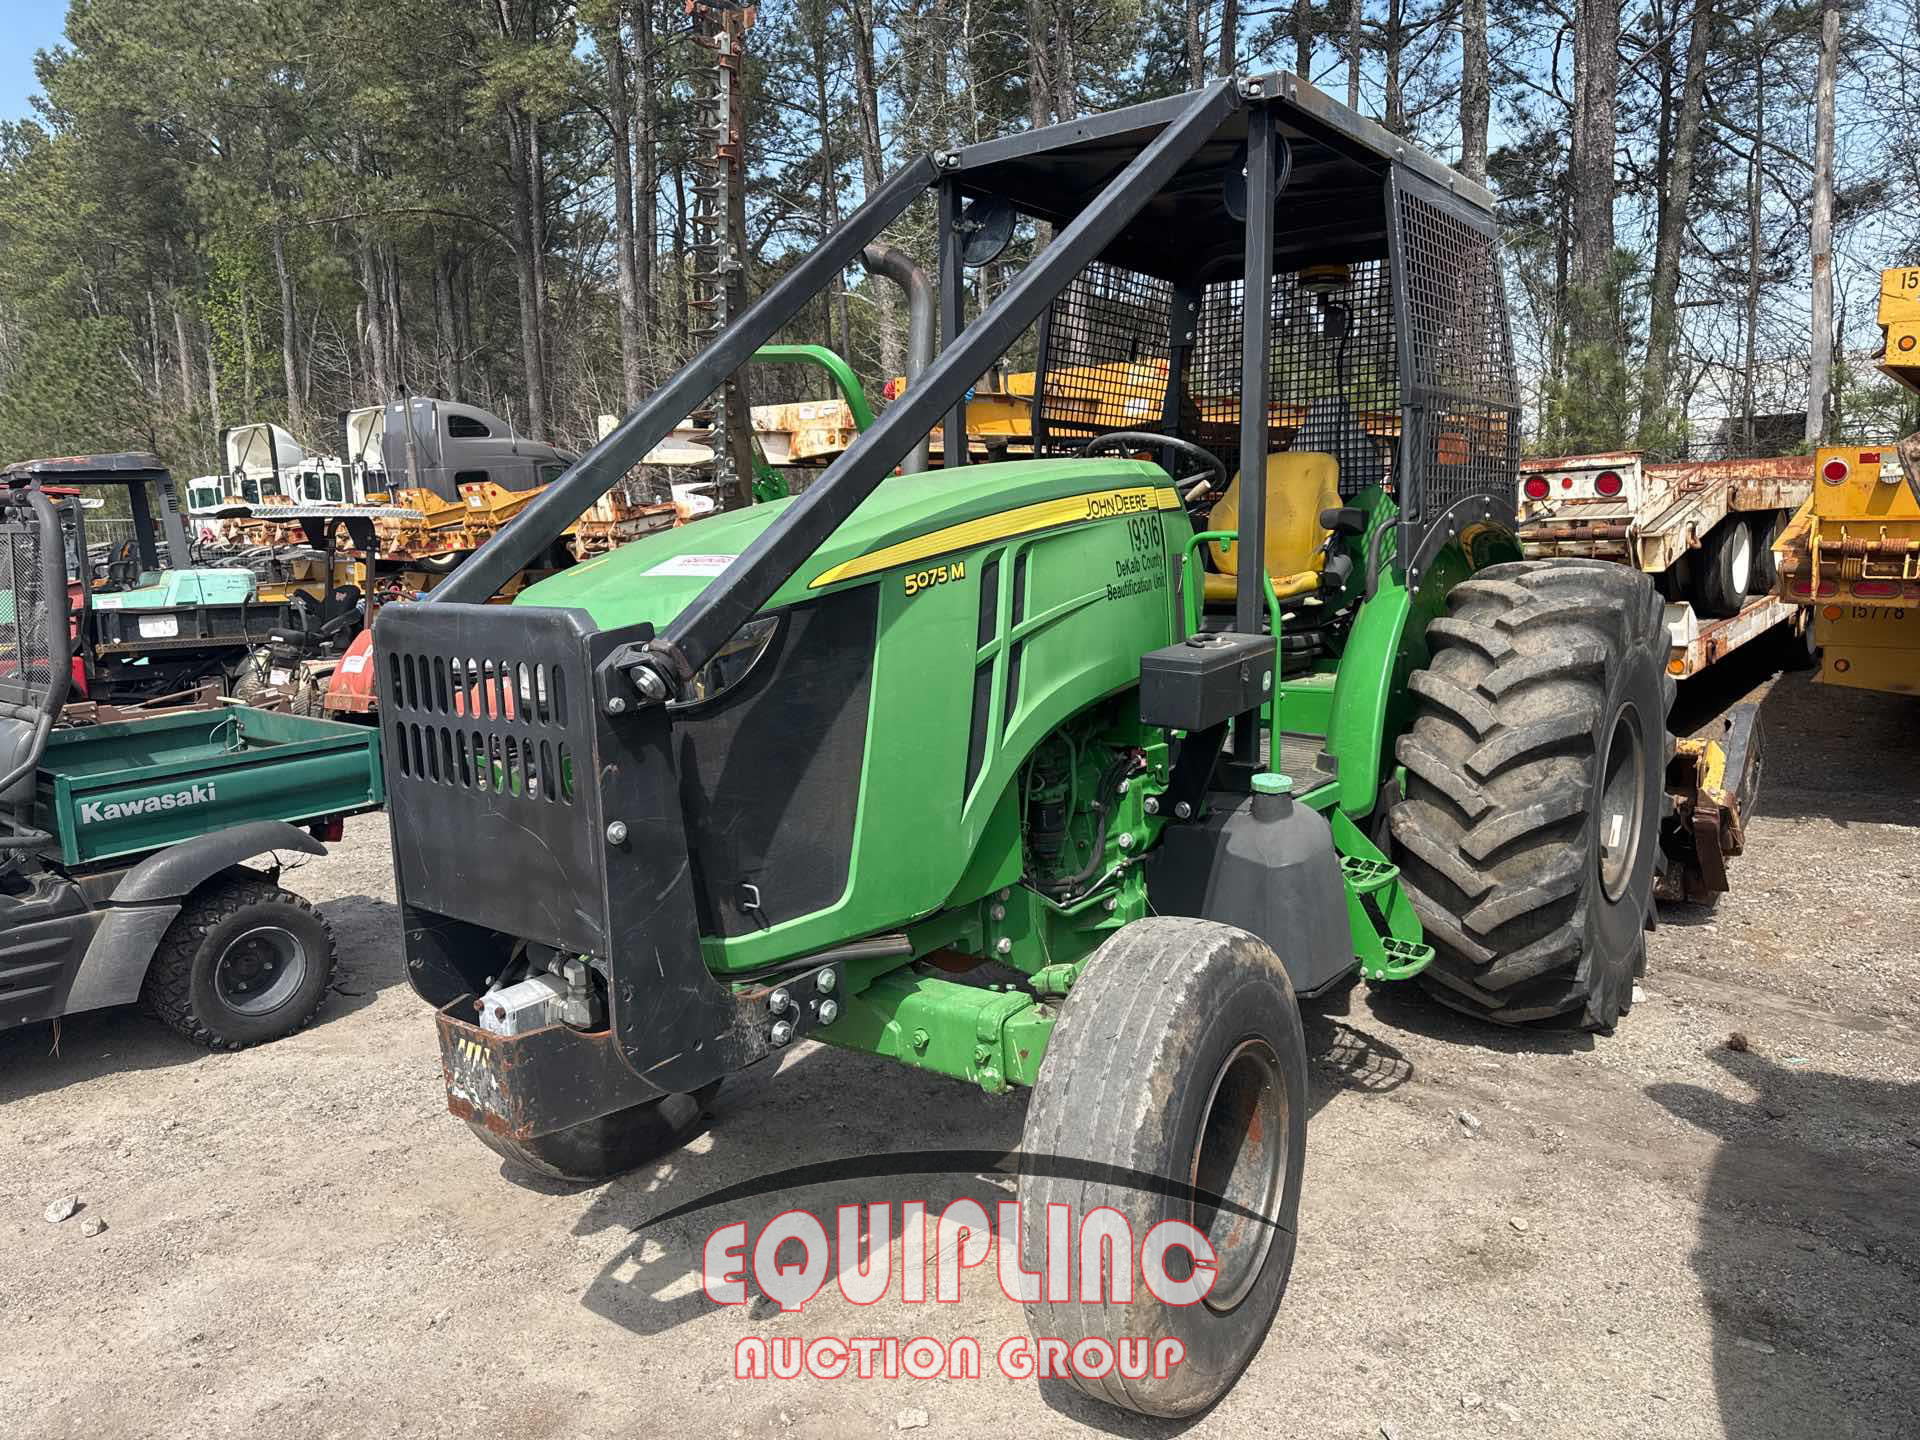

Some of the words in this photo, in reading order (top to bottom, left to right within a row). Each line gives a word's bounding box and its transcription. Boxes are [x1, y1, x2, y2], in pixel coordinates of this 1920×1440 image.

[1086, 497, 1115, 517] JOHN
[1114, 494, 1148, 512] DEERE
[1127, 515, 1160, 552] 19316
[904, 565, 948, 597] 5075
[951, 560, 966, 581] M
[1116, 555, 1141, 577] DeKalb
[1142, 554, 1162, 571] County
[1106, 577, 1153, 600] Beautification
[81, 782, 216, 824] Kawasaki
